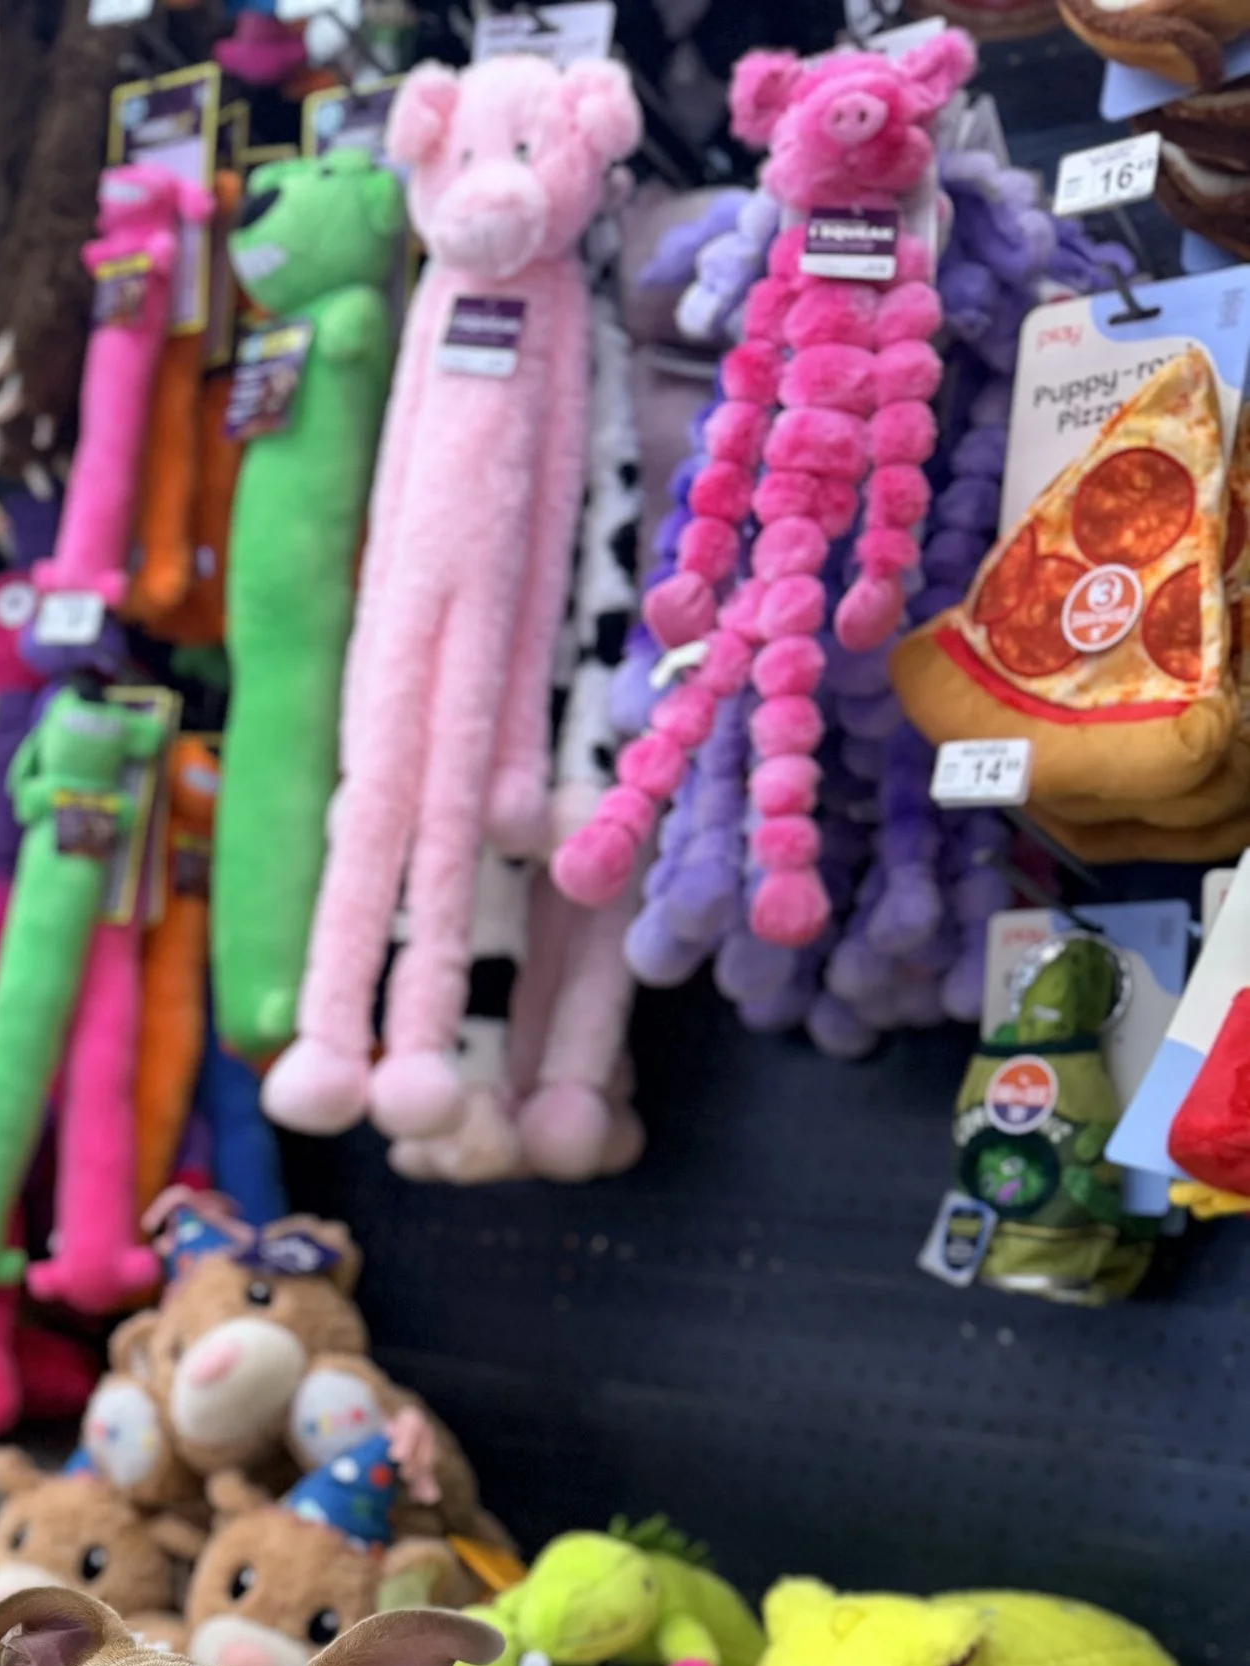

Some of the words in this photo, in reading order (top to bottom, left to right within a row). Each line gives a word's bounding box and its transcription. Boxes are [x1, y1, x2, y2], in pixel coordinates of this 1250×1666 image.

[1101, 163, 1134, 193] 16
[1033, 342, 1193, 408] Puppy-ro
[973, 759, 1001, 786] 14
